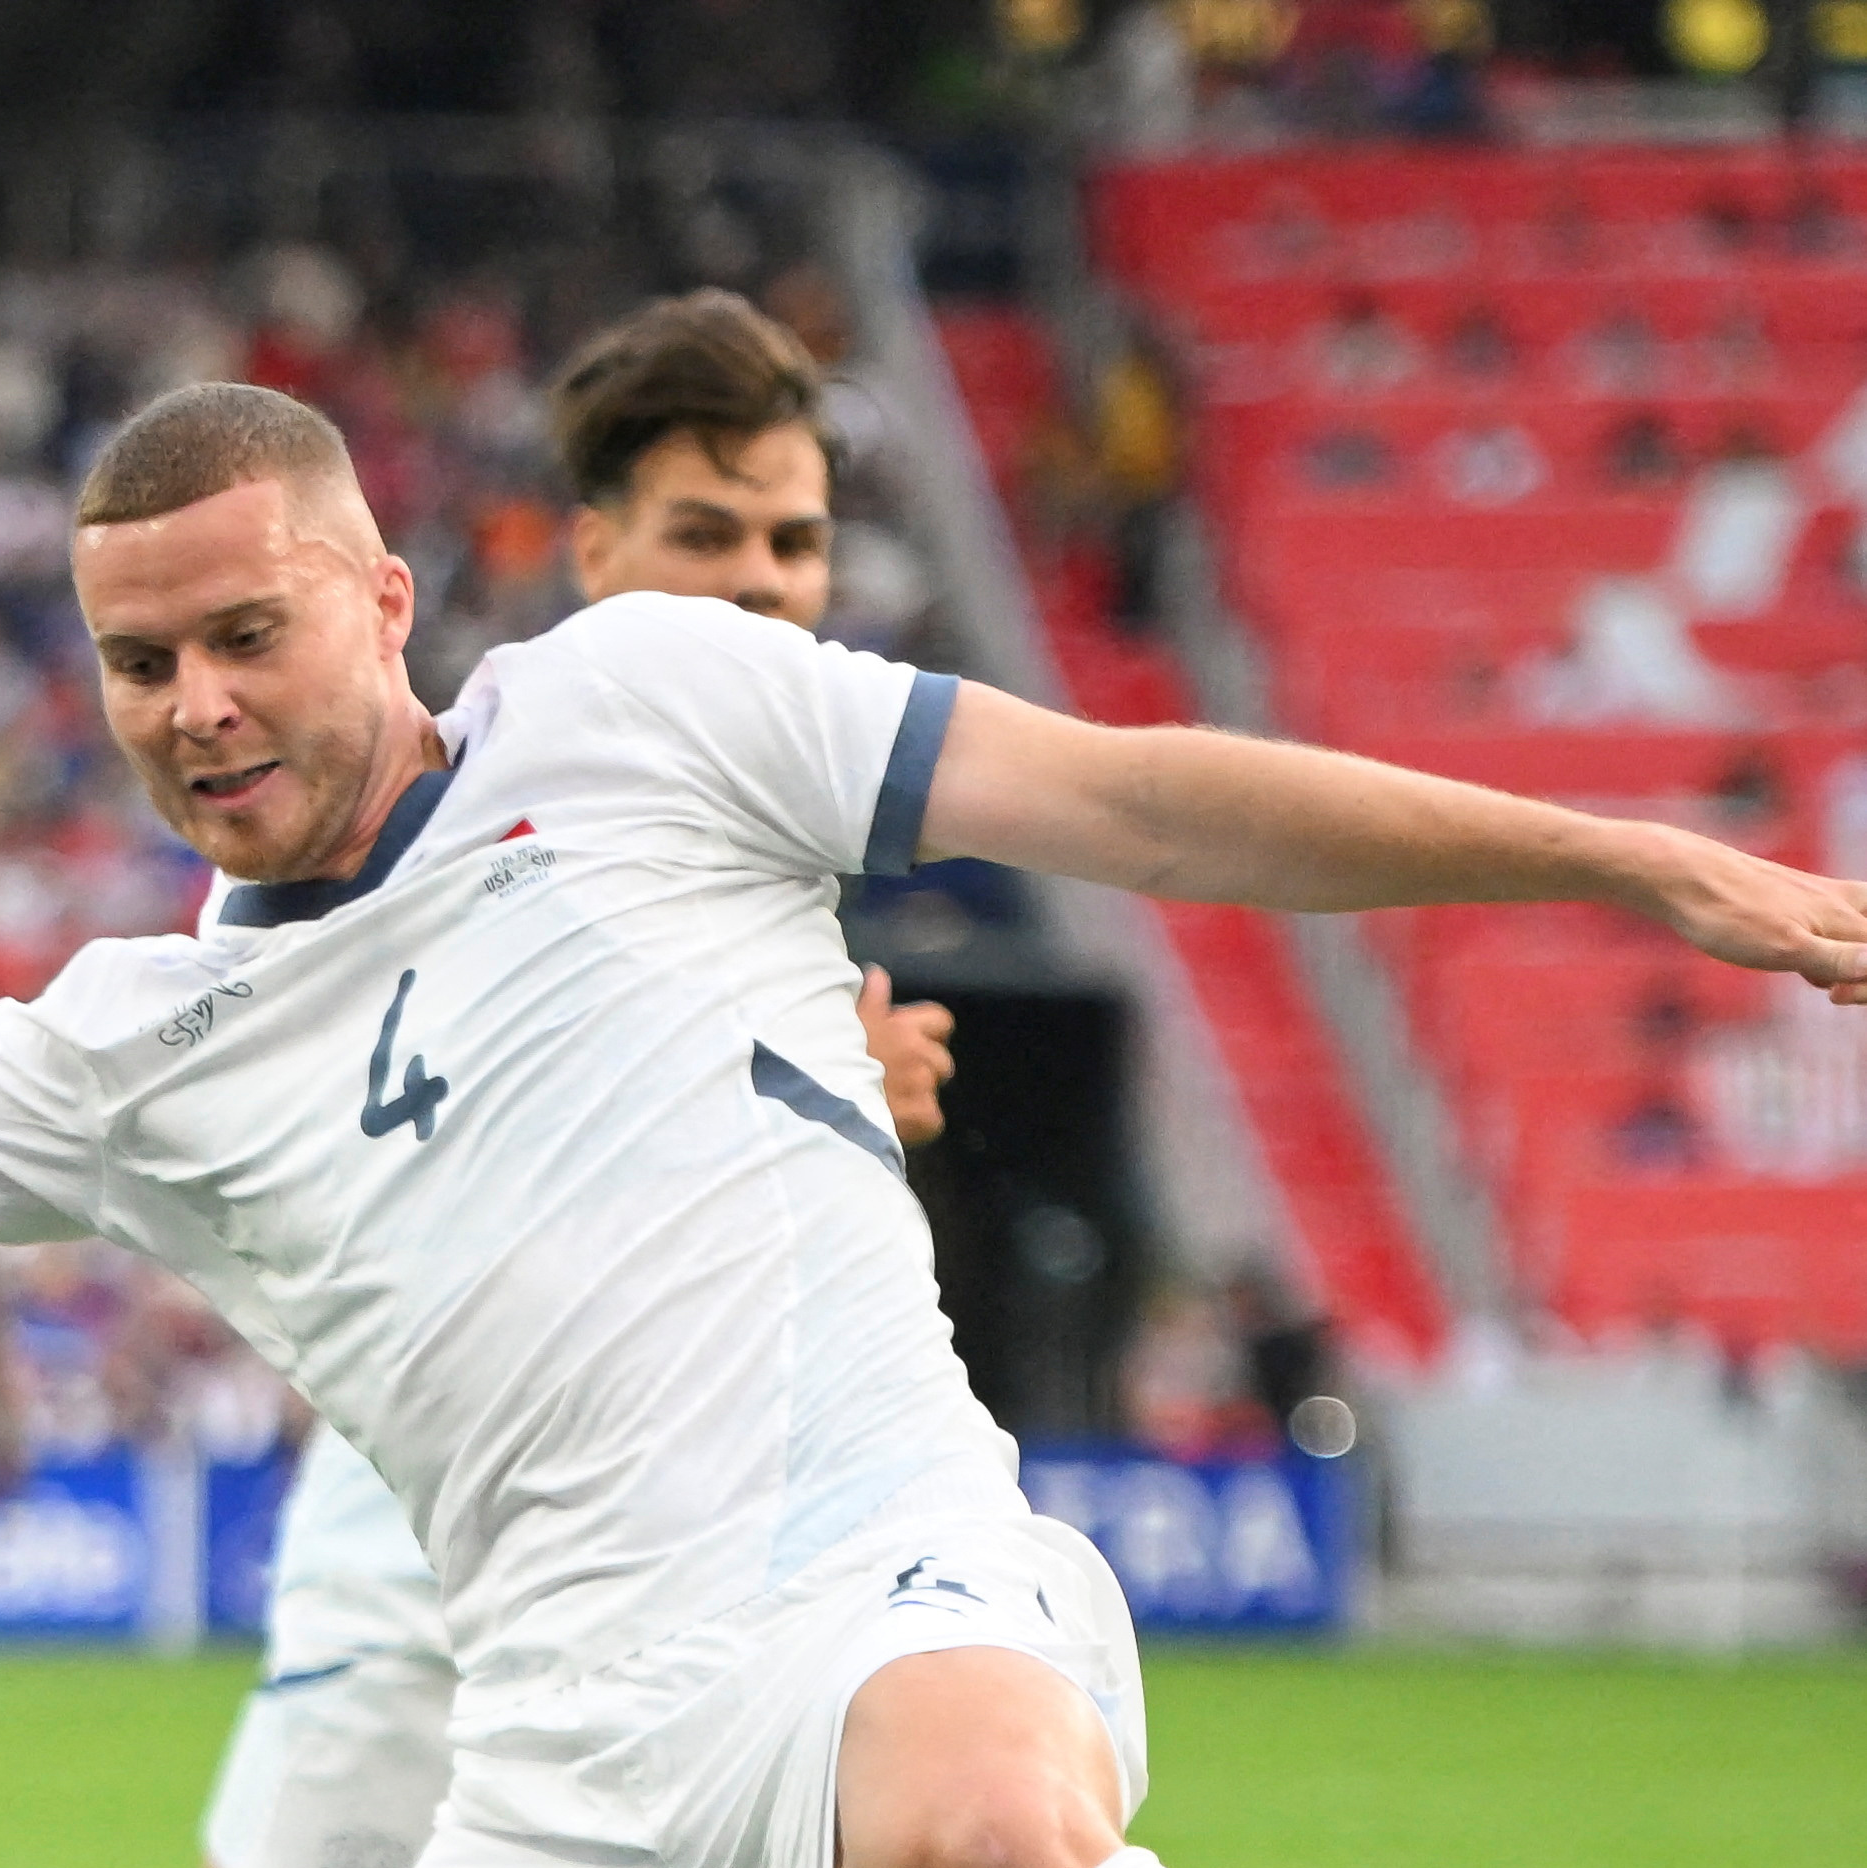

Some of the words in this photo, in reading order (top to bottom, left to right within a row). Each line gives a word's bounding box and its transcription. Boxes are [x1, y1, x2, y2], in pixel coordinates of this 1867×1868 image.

[530, 849, 557, 869] SUI
[484, 868, 515, 893] USA
[361, 968, 450, 1142] 4
